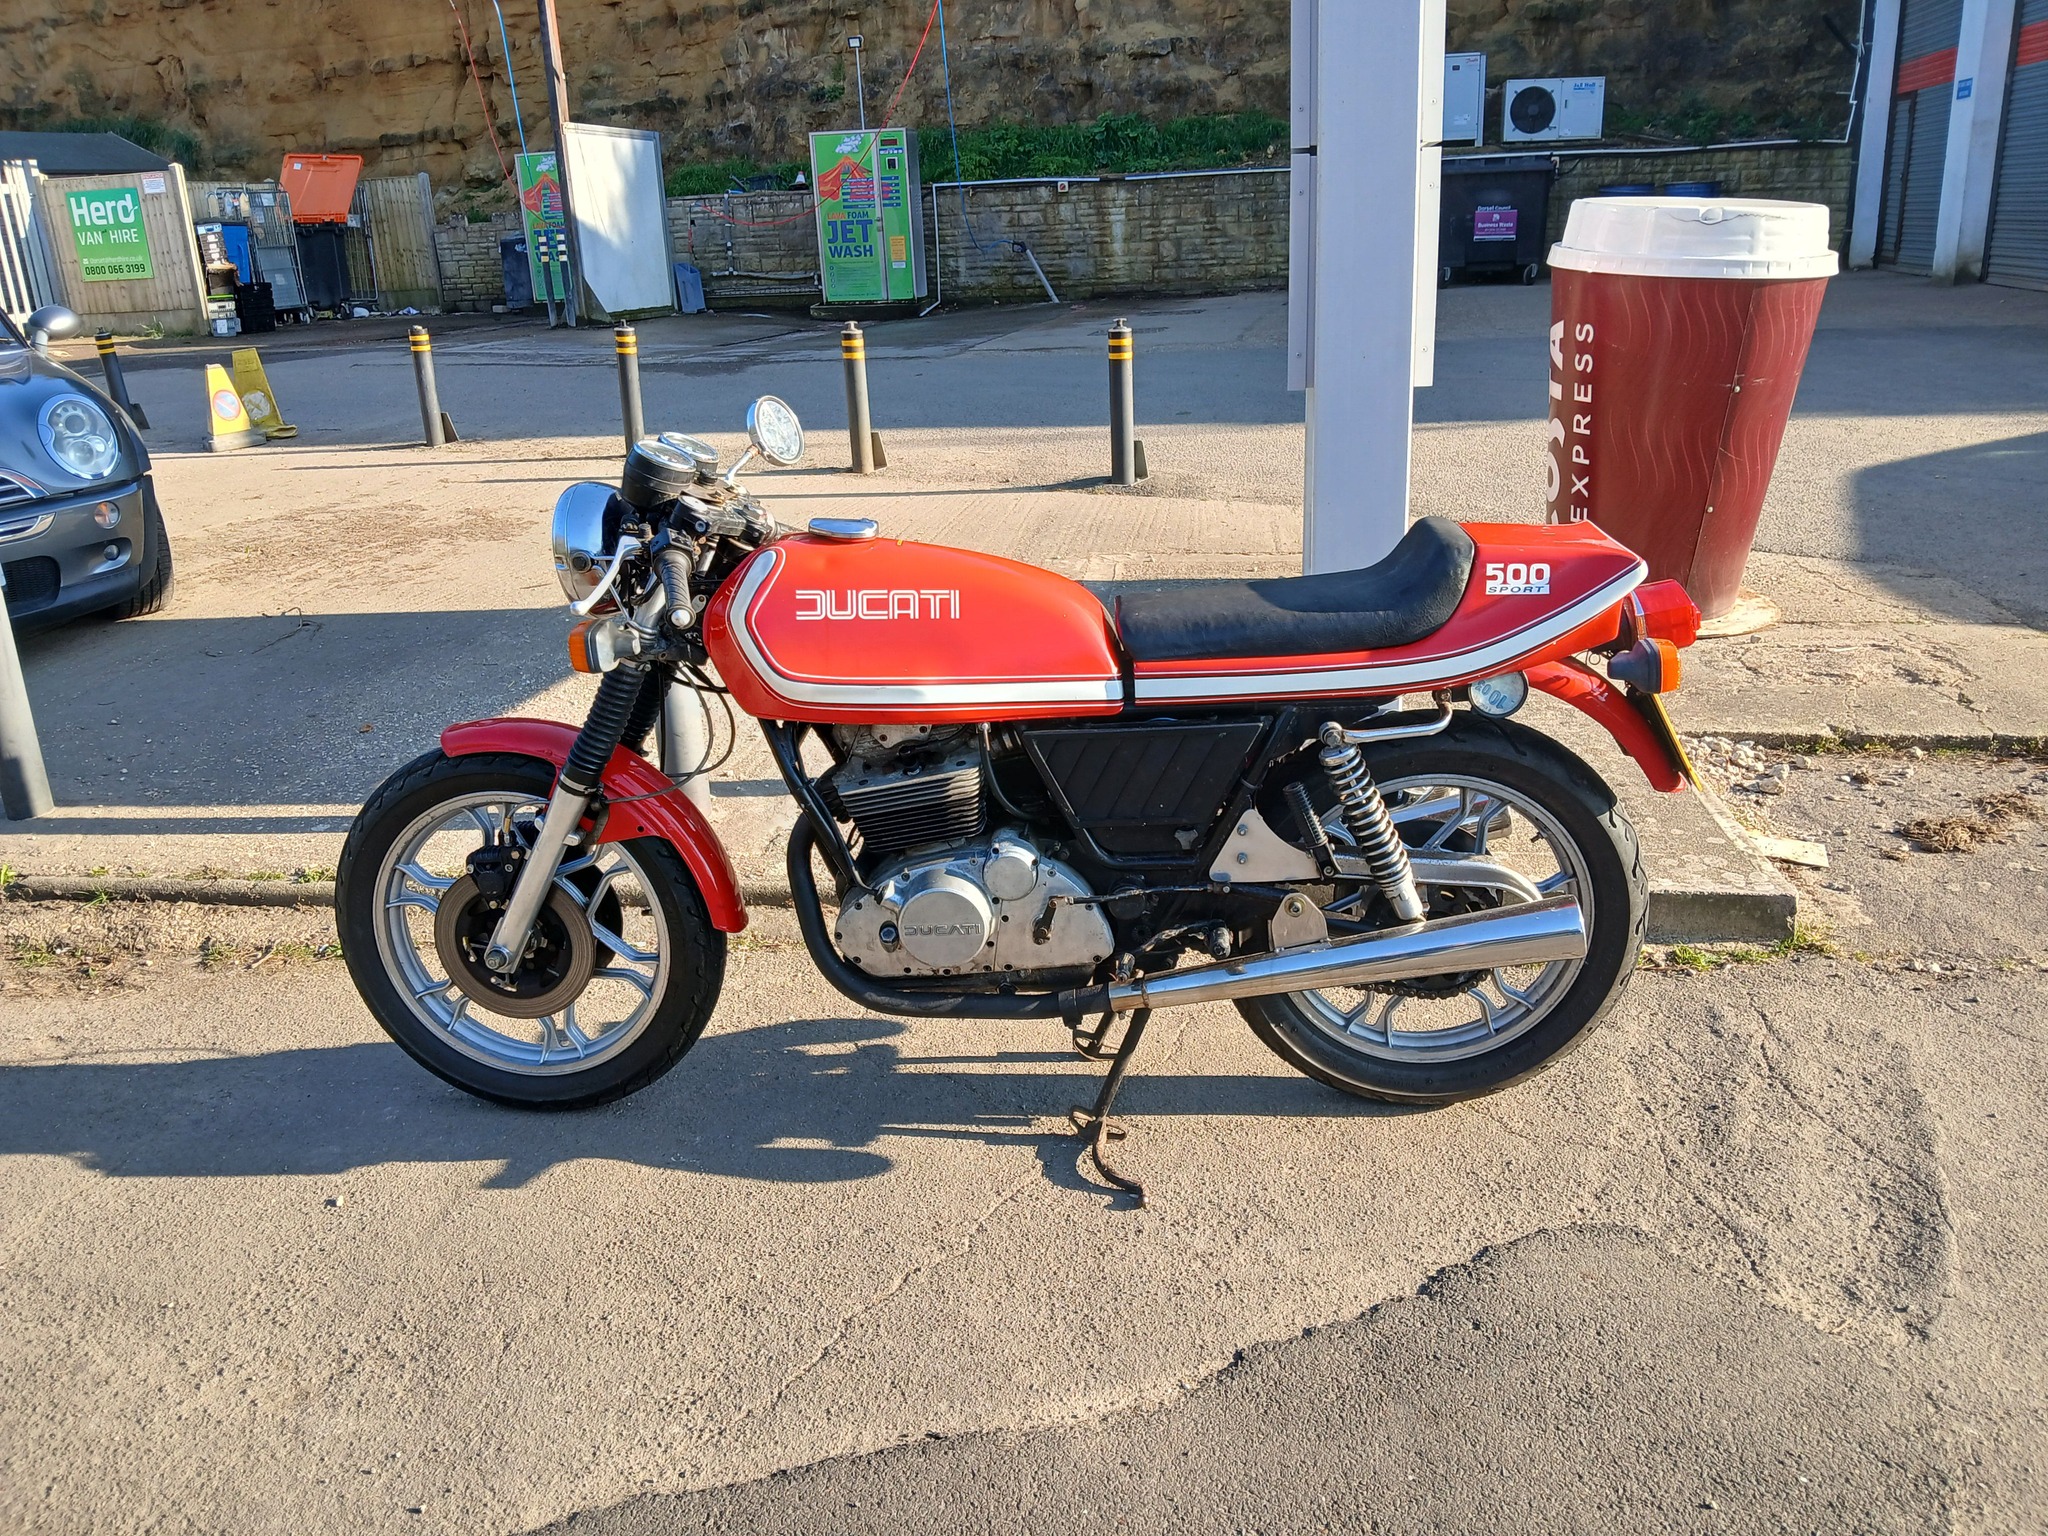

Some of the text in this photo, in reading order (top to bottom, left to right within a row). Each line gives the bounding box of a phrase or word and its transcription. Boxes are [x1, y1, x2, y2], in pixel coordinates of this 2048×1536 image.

[70, 194, 138, 226] Herd
[827, 211, 869, 220] LAVA FOAM
[77, 231, 103, 246] VAN
[109, 229, 140, 243] HIRE
[827, 219, 873, 244] JET
[828, 244, 874, 258] WASH
[85, 263, 146, 276] 0800 066 3199
[1571, 323, 1595, 525] EXPRESS
[1485, 562, 1551, 586] 500
[1487, 585, 1545, 594] SPORT
[795, 589, 960, 621] DUCATI
[903, 922, 983, 937] DUCATI
